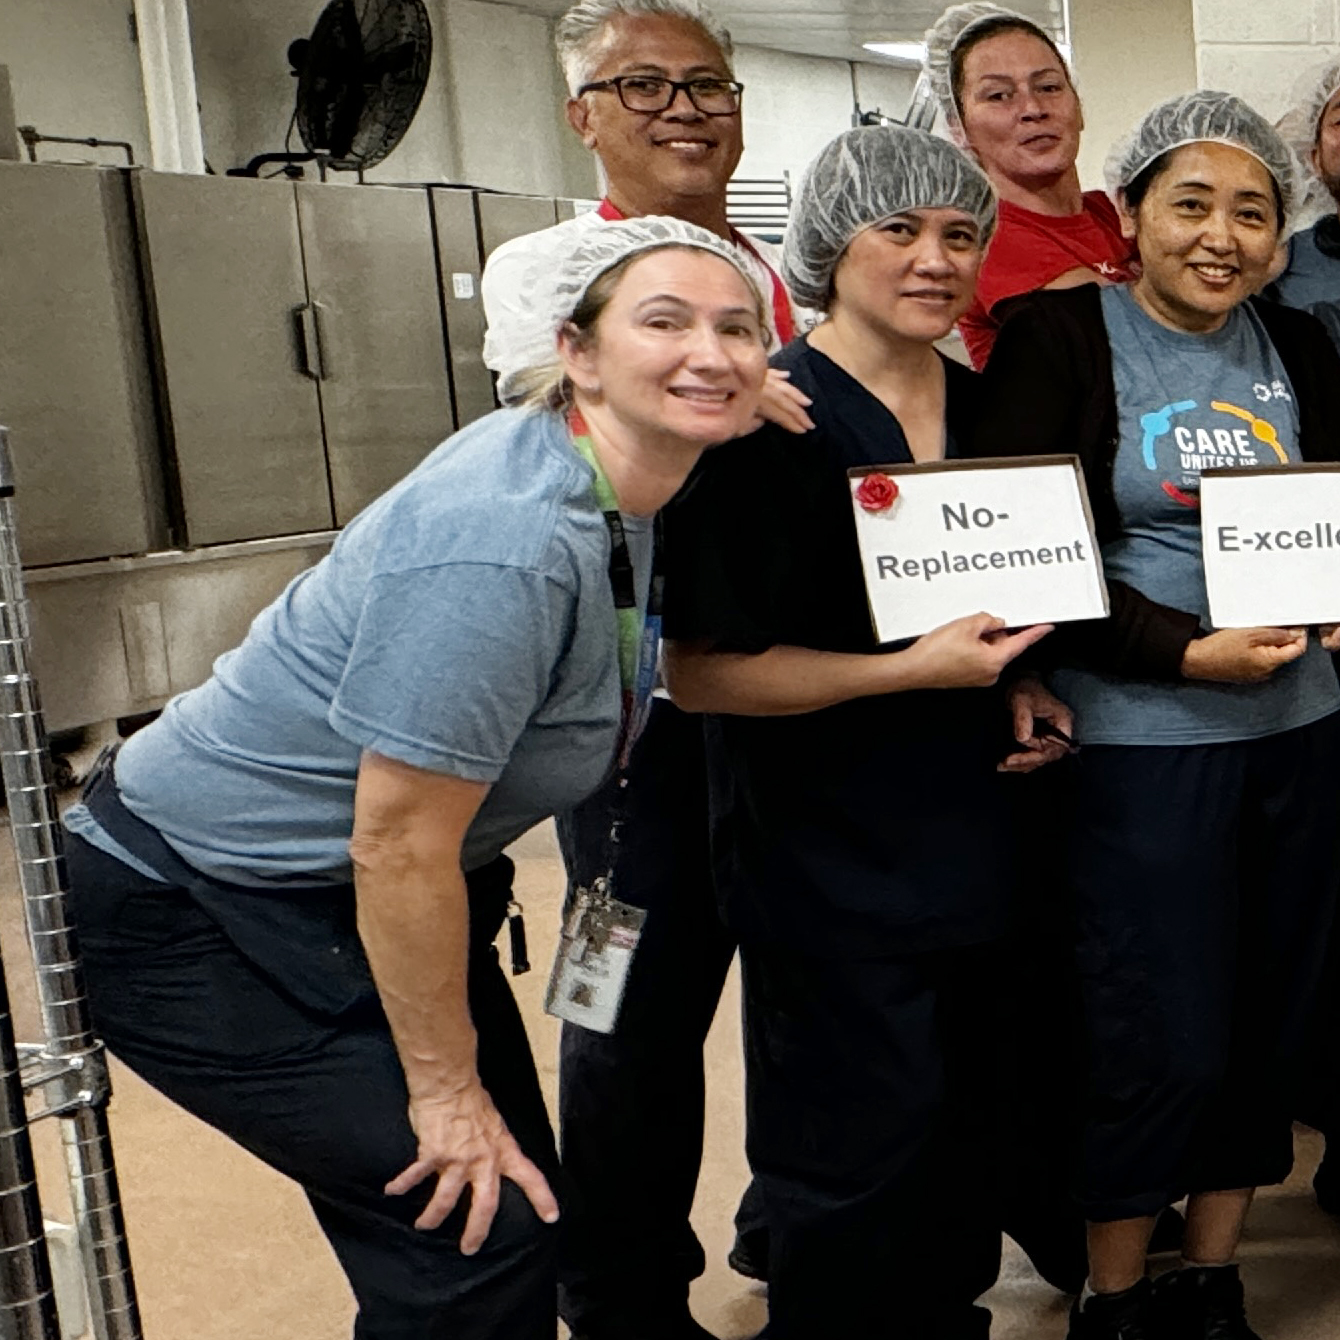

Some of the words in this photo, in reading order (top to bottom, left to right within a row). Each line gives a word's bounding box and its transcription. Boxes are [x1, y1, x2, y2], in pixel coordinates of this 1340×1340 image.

[1174, 426, 1256, 457] CARE
[941, 502, 1010, 531] No-
[876, 539, 1087, 582] Replacement
